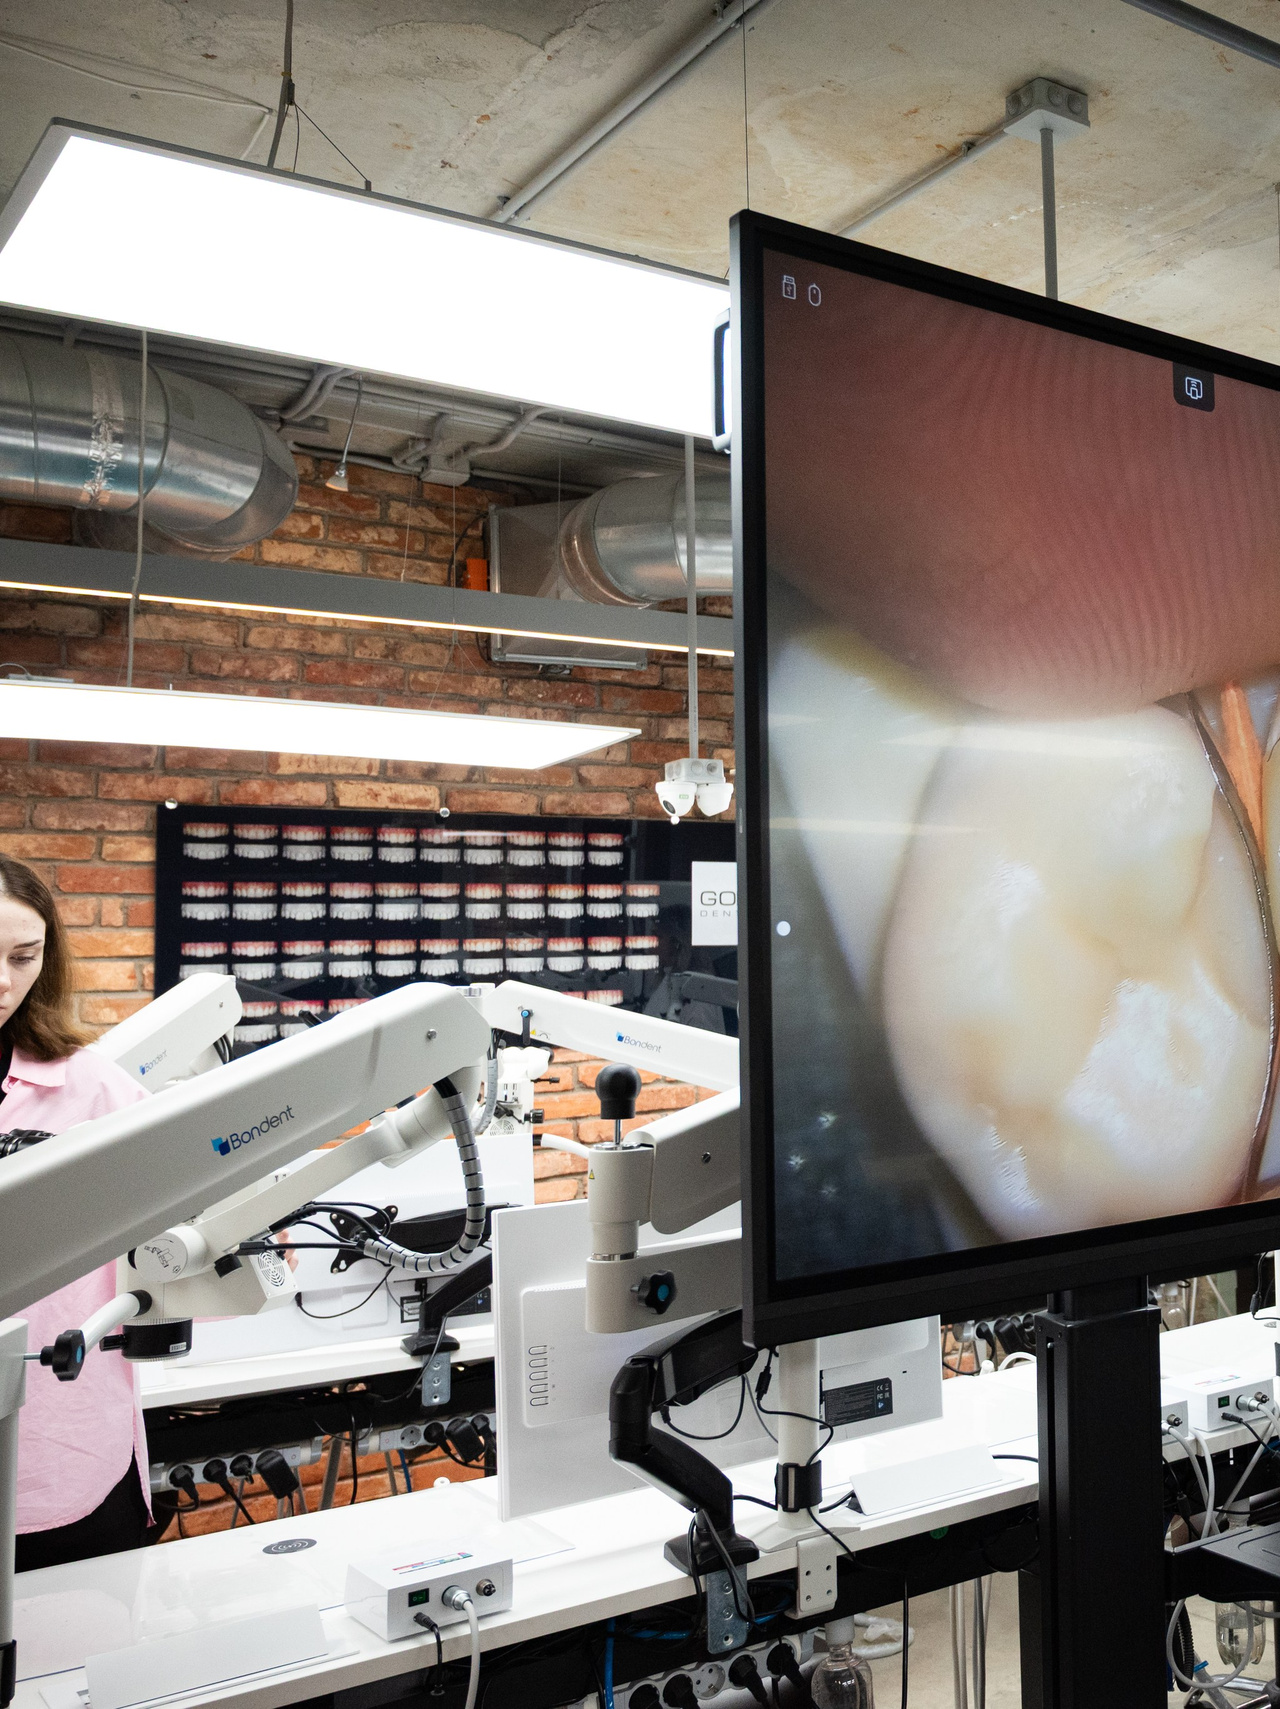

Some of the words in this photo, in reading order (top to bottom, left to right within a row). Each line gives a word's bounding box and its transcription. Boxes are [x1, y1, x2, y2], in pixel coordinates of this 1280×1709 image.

[700, 891, 736, 906] GO
[624, 1035, 661, 1053] Bondent
[229, 1105, 295, 1150] Bondent
